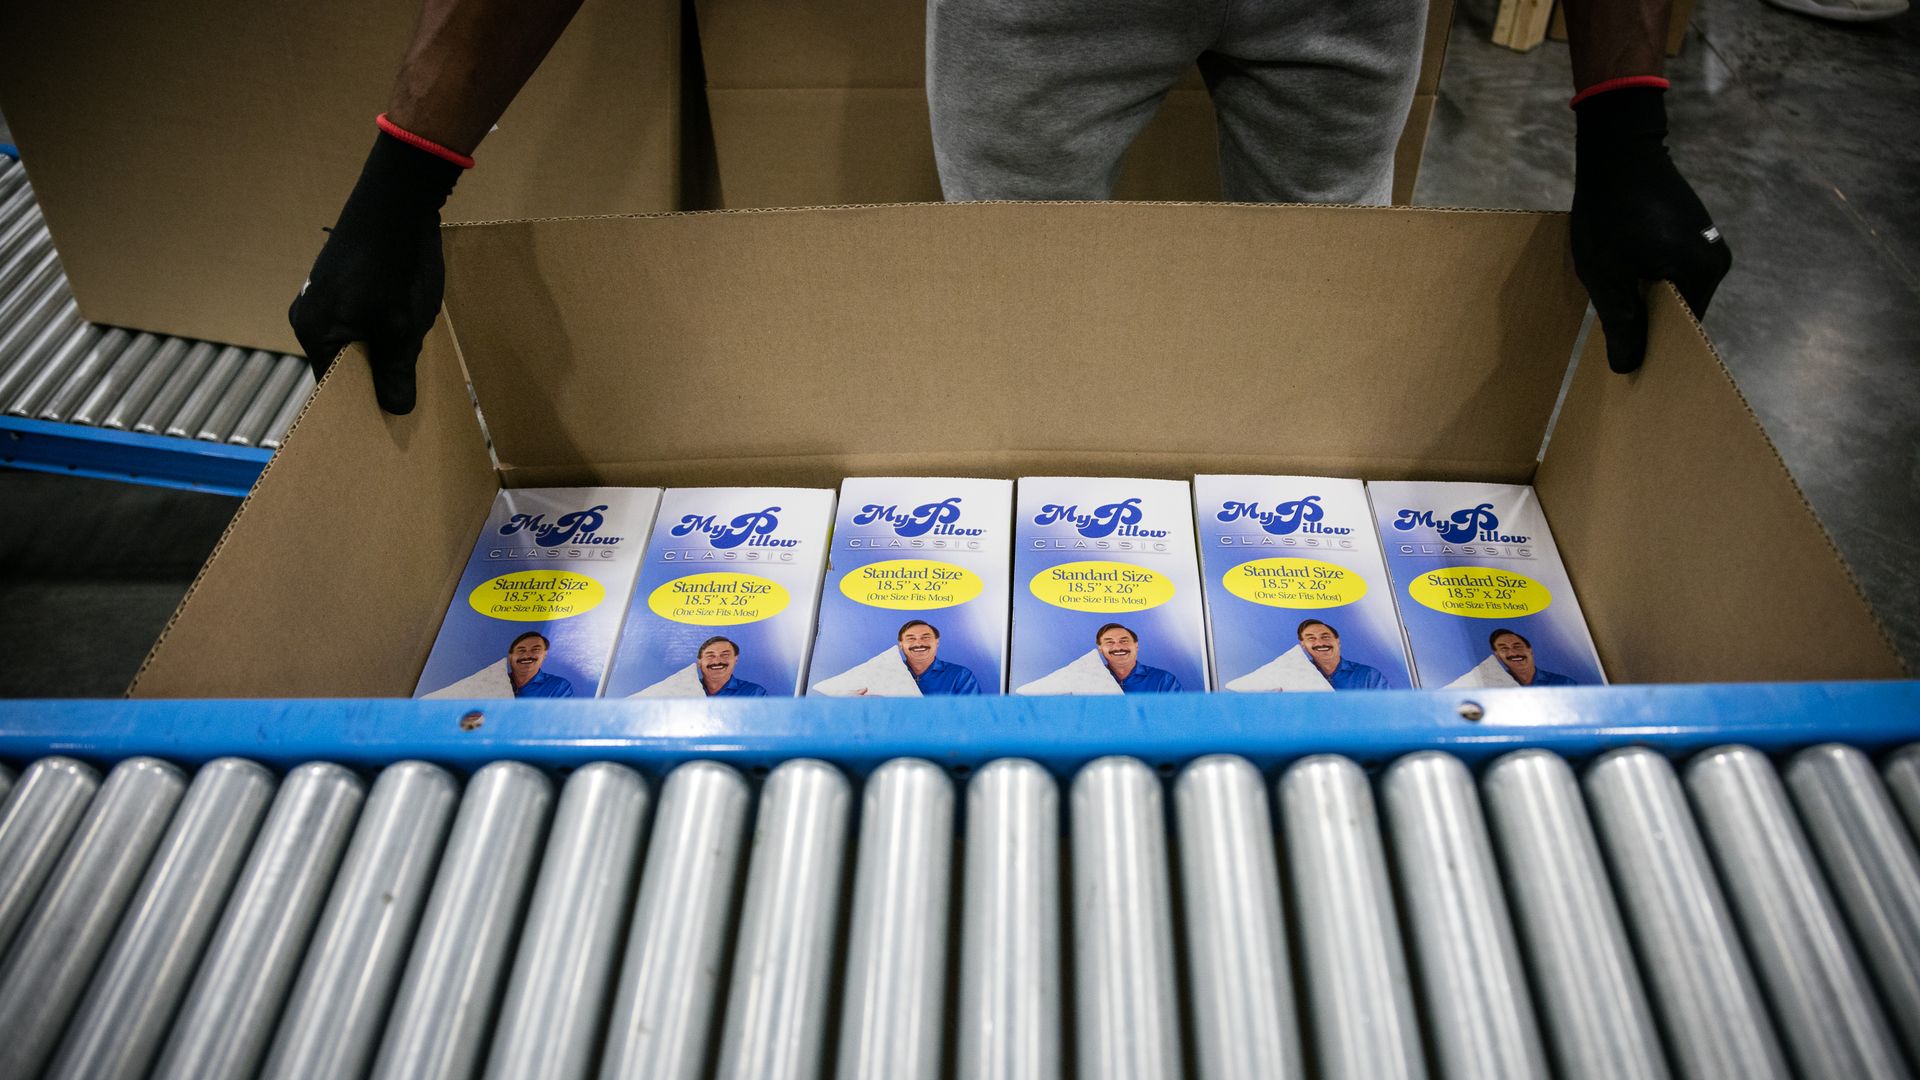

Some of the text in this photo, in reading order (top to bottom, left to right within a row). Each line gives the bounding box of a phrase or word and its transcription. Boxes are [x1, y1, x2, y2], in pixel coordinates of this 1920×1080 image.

[850, 539, 979, 549] CLASSIC
[1034, 540, 1167, 551] CLASSIC
[1220, 536, 1352, 548] CLASSIC
[490, 550, 614, 558] CLASSIC
[664, 551, 793, 560] CLASSIC
[1401, 545, 1531, 557] CLASSIC
[863, 567, 962, 580] Standard Size
[1052, 569, 1152, 582] Standard Size
[1244, 565, 1344, 579] Standard Size
[493, 578, 588, 590] Standard Size
[1428, 574, 1527, 588] Standard Size
[672, 581, 771, 593] Standard Size
[867, 593, 888, 601] (One
[928, 594, 954, 602] Most)
[1059, 595, 1081, 603] (One
[1104, 596, 1119, 604] Fits
[1122, 597, 1147, 605] Most)
[1254, 591, 1276, 599] (One
[1300, 592, 1314, 600] Fits
[1316, 593, 1342, 602] Most)
[491, 605, 512, 613] (One
[548, 605, 573, 613] Most)
[1442, 601, 1464, 609] (One
[673, 608, 694, 616] (One
[696, 608, 714, 616] Size
[734, 609, 758, 617] Most)
